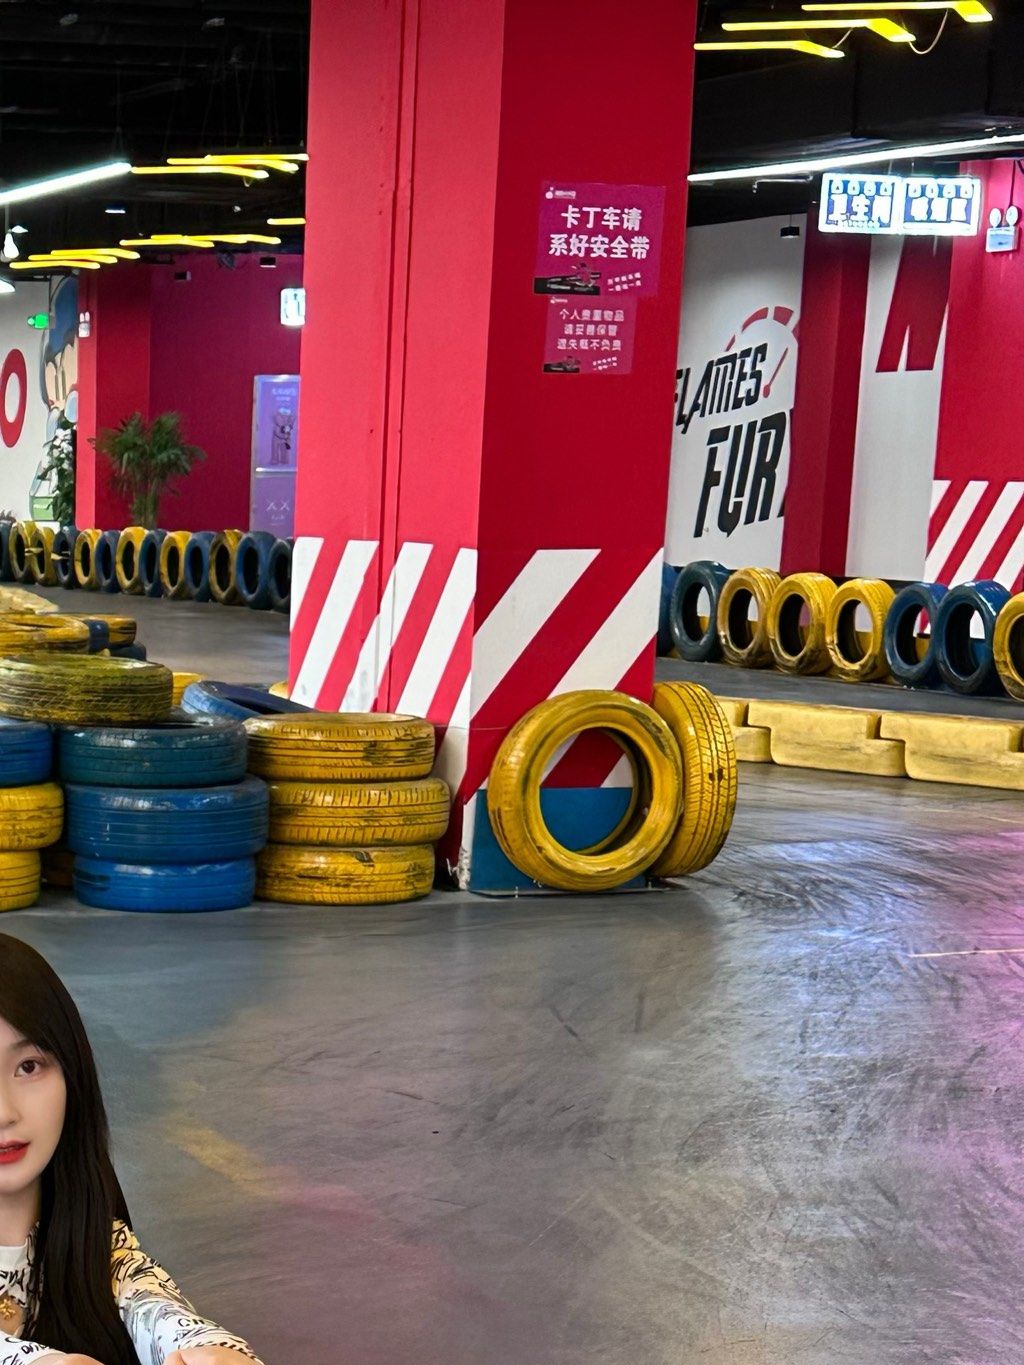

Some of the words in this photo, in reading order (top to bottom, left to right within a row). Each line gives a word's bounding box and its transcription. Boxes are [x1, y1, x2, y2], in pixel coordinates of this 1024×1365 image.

[560, 205, 642, 231] 卡丁车请
[548, 234, 650, 260] 系好安全带
[693, 409, 792, 538] FUR
